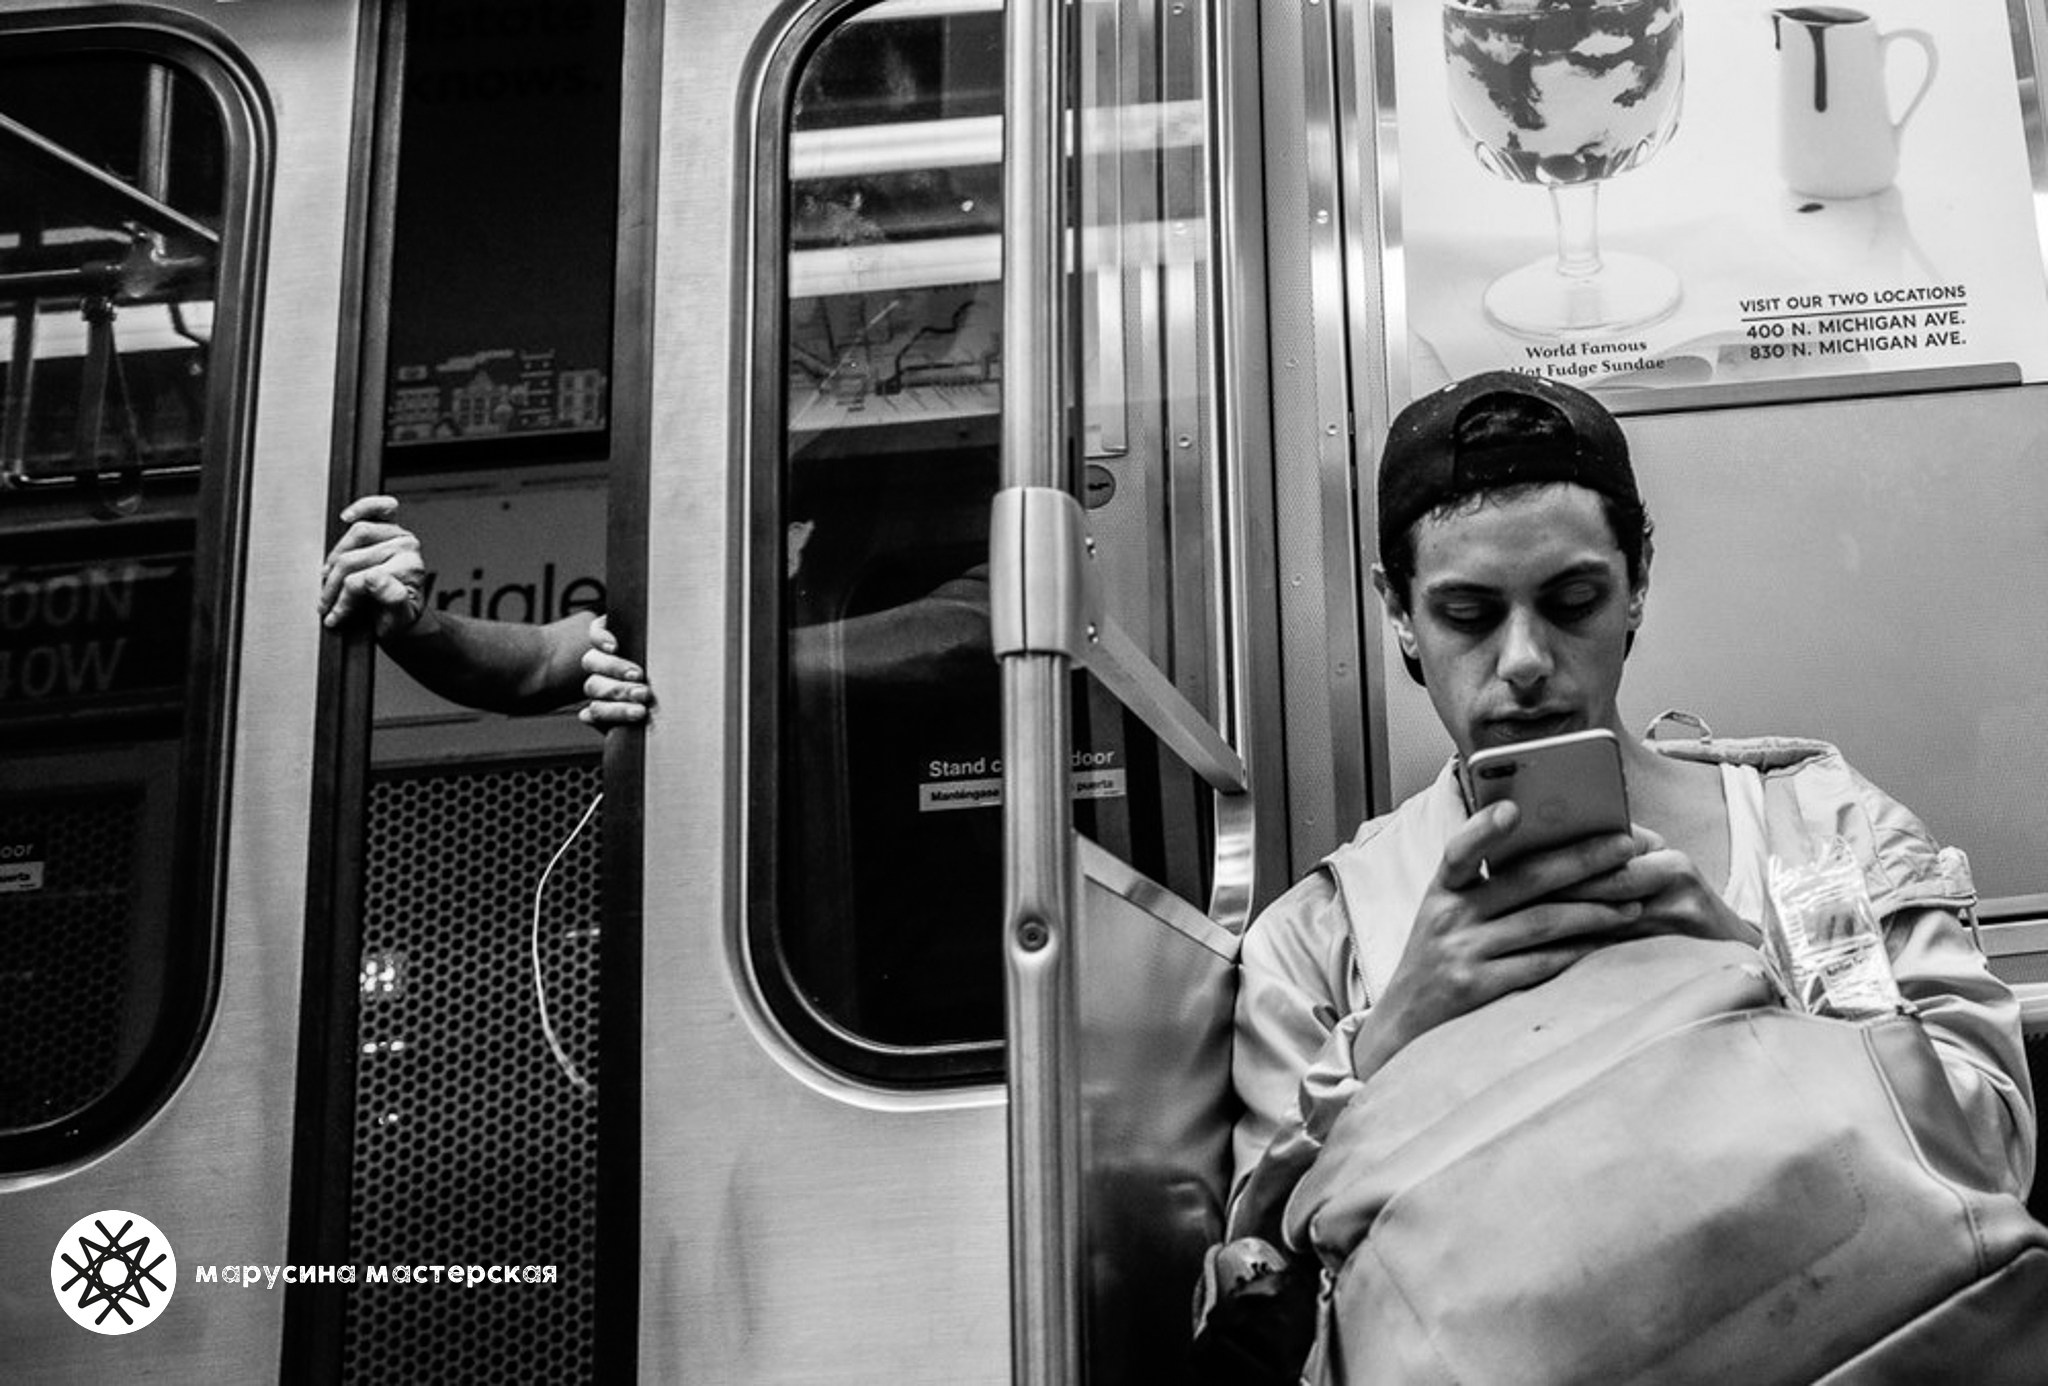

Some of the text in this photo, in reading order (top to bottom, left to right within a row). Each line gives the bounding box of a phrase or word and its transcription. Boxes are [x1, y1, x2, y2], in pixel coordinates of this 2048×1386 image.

[1740, 285, 1966, 312] VISIT OUR TWO LOCATIONS
[1747, 310, 1966, 339] 400 N. MICHIGAN AVE.
[1525, 341, 1647, 359] World Famous
[1750, 330, 1966, 360] 830 N. MICHIGAN AVE.
[1547, 362, 1598, 377] Fudge
[1602, 358, 1665, 374] Sundae
[929, 757, 986, 778] Stand
[1072, 750, 1115, 767] door
